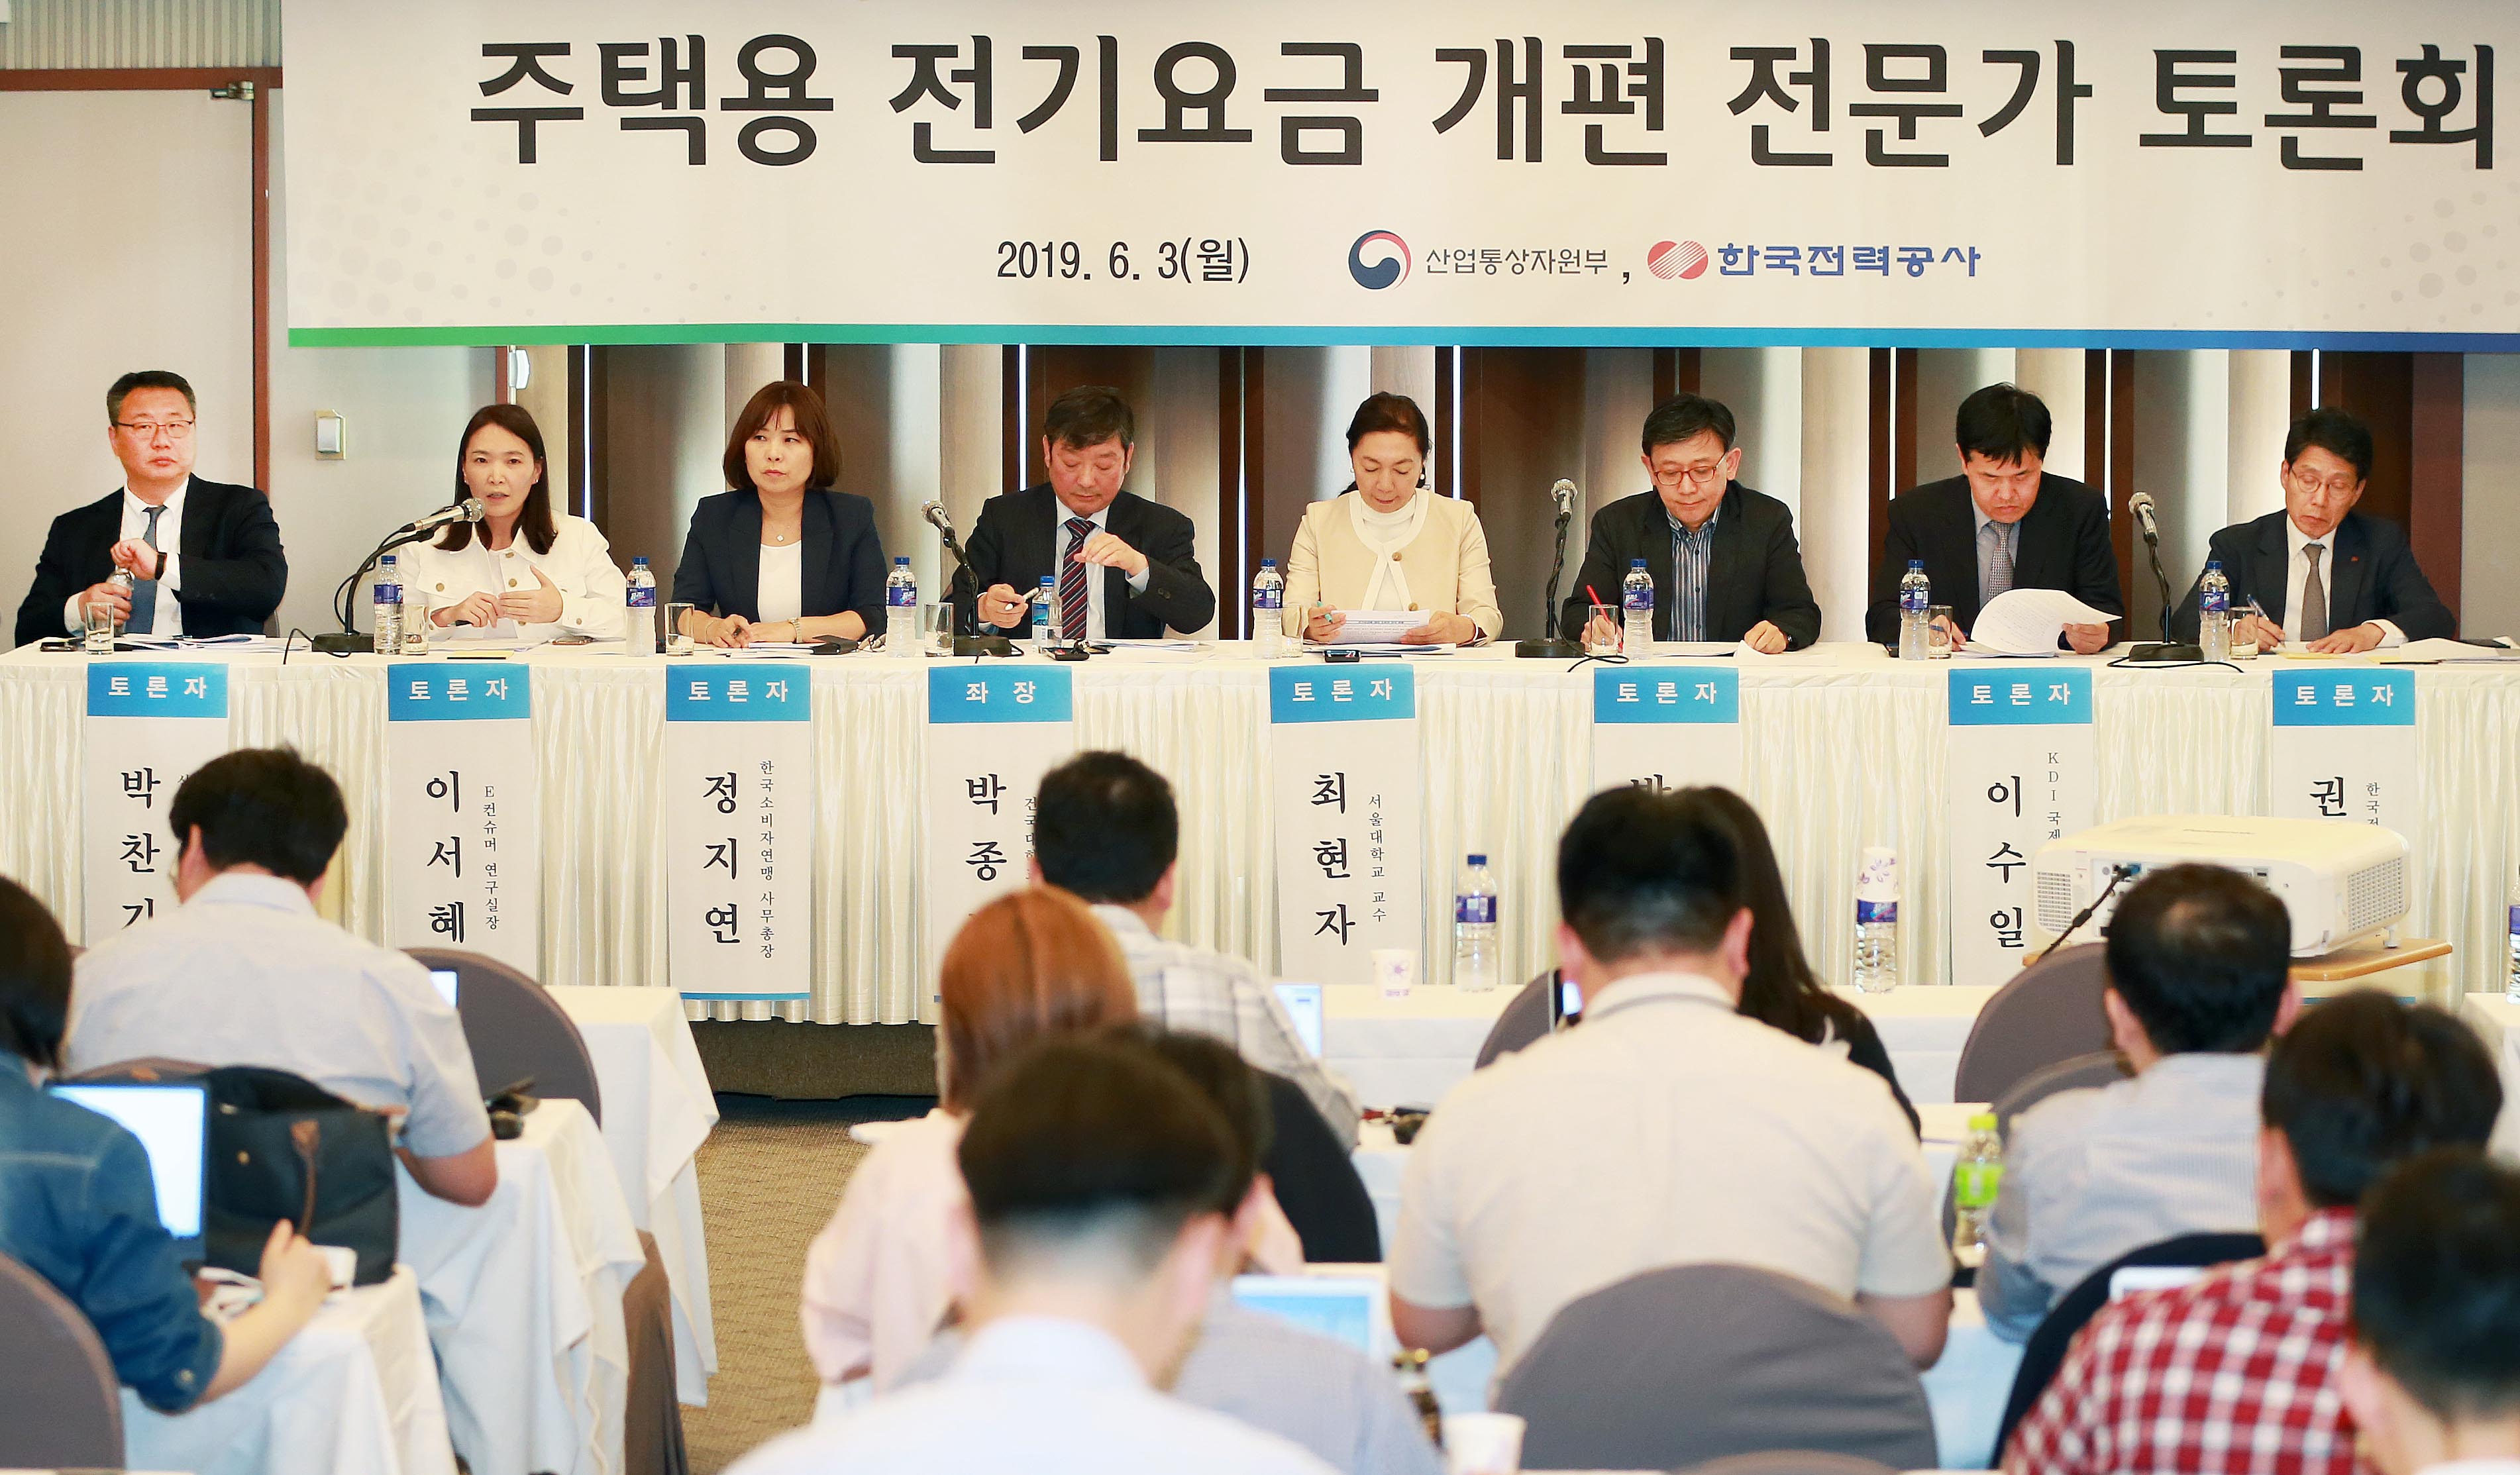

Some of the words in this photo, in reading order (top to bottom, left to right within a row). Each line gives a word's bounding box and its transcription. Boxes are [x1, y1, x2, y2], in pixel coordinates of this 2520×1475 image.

[470, 33, 835, 167] 주택용
[888, 34, 1380, 166] 전기요금
[1431, 36, 1668, 167] 개편
[1726, 37, 2093, 168] 전문가
[2138, 43, 2495, 172] 토론회
[996, 240, 1092, 281] 2019.
[1108, 240, 1141, 281] 6.
[1157, 236, 1250, 284] 3(월)
[1426, 247, 1609, 276] 산업통상자원부
[1717, 242, 1982, 278] 한국전력공사
[425, 770, 465, 944] 이서혜
[482, 785, 498, 853] E컨슈머
[702, 771, 741, 944] 정지연
[759, 760, 775, 882] 한국소비자연맹
[1368, 793, 1385, 878] 서울대학교
[484, 862, 500, 931] 연구실장
[1310, 771, 1357, 946] 최현자
[1985, 775, 2027, 948] 이수일
[759, 890, 775, 959] 사무총장
[1371, 890, 1387, 923] 교수
